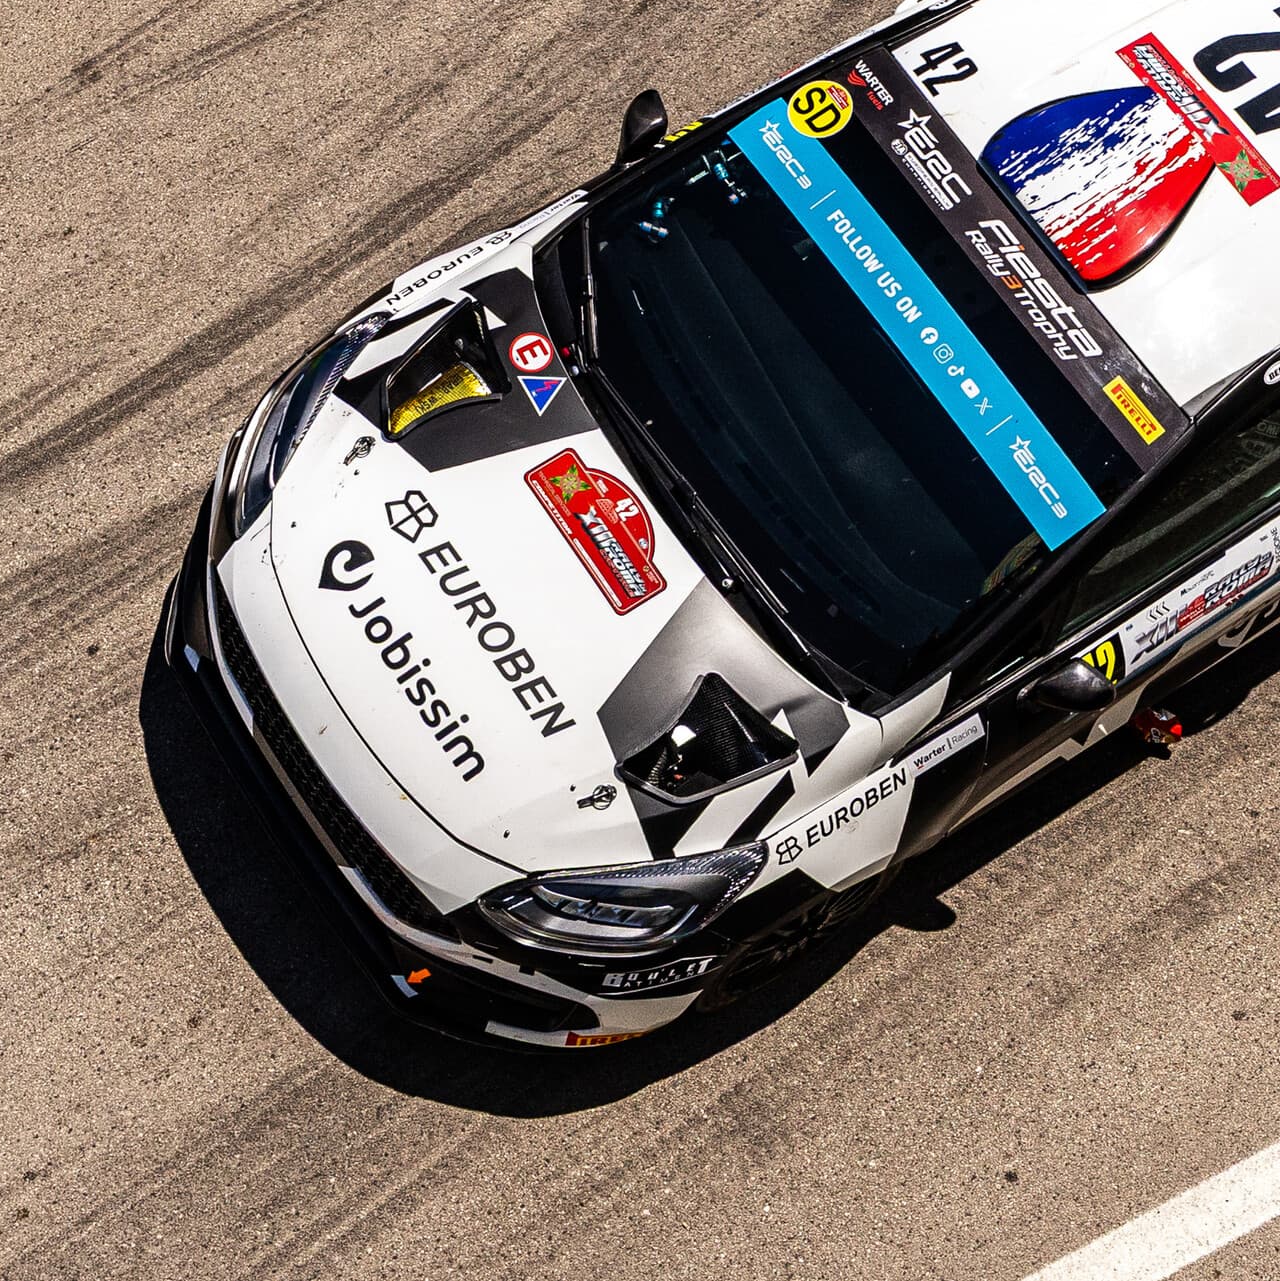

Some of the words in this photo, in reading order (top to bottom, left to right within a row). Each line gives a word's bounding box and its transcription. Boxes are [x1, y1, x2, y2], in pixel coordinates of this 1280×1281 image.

[854, 60, 894, 106] WARTER
[914, 42, 979, 97] 42
[794, 87, 841, 134] SD
[900, 116, 972, 204] ERC
[386, 246, 484, 306] EUROBEN
[826, 209, 884, 272] FOLLOW
[877, 272, 902, 298] US
[896, 297, 922, 324] ON
[978, 219, 1103, 358] Fiesta
[516, 338, 549, 366] E
[1111, 383, 1157, 437] PIRELLI
[615, 498, 640, 522] 42
[604, 545, 644, 595] ROMA
[611, 541, 644, 582] RALLY
[1205, 554, 1260, 598] RALLY
[1205, 558, 1269, 608] ROMA
[418, 542, 576, 738] EUROBEN
[348, 596, 485, 782] Jobissim
[913, 744, 946, 769] Warter
[952, 724, 978, 745] Racing
[806, 768, 907, 848] EUROBEN
